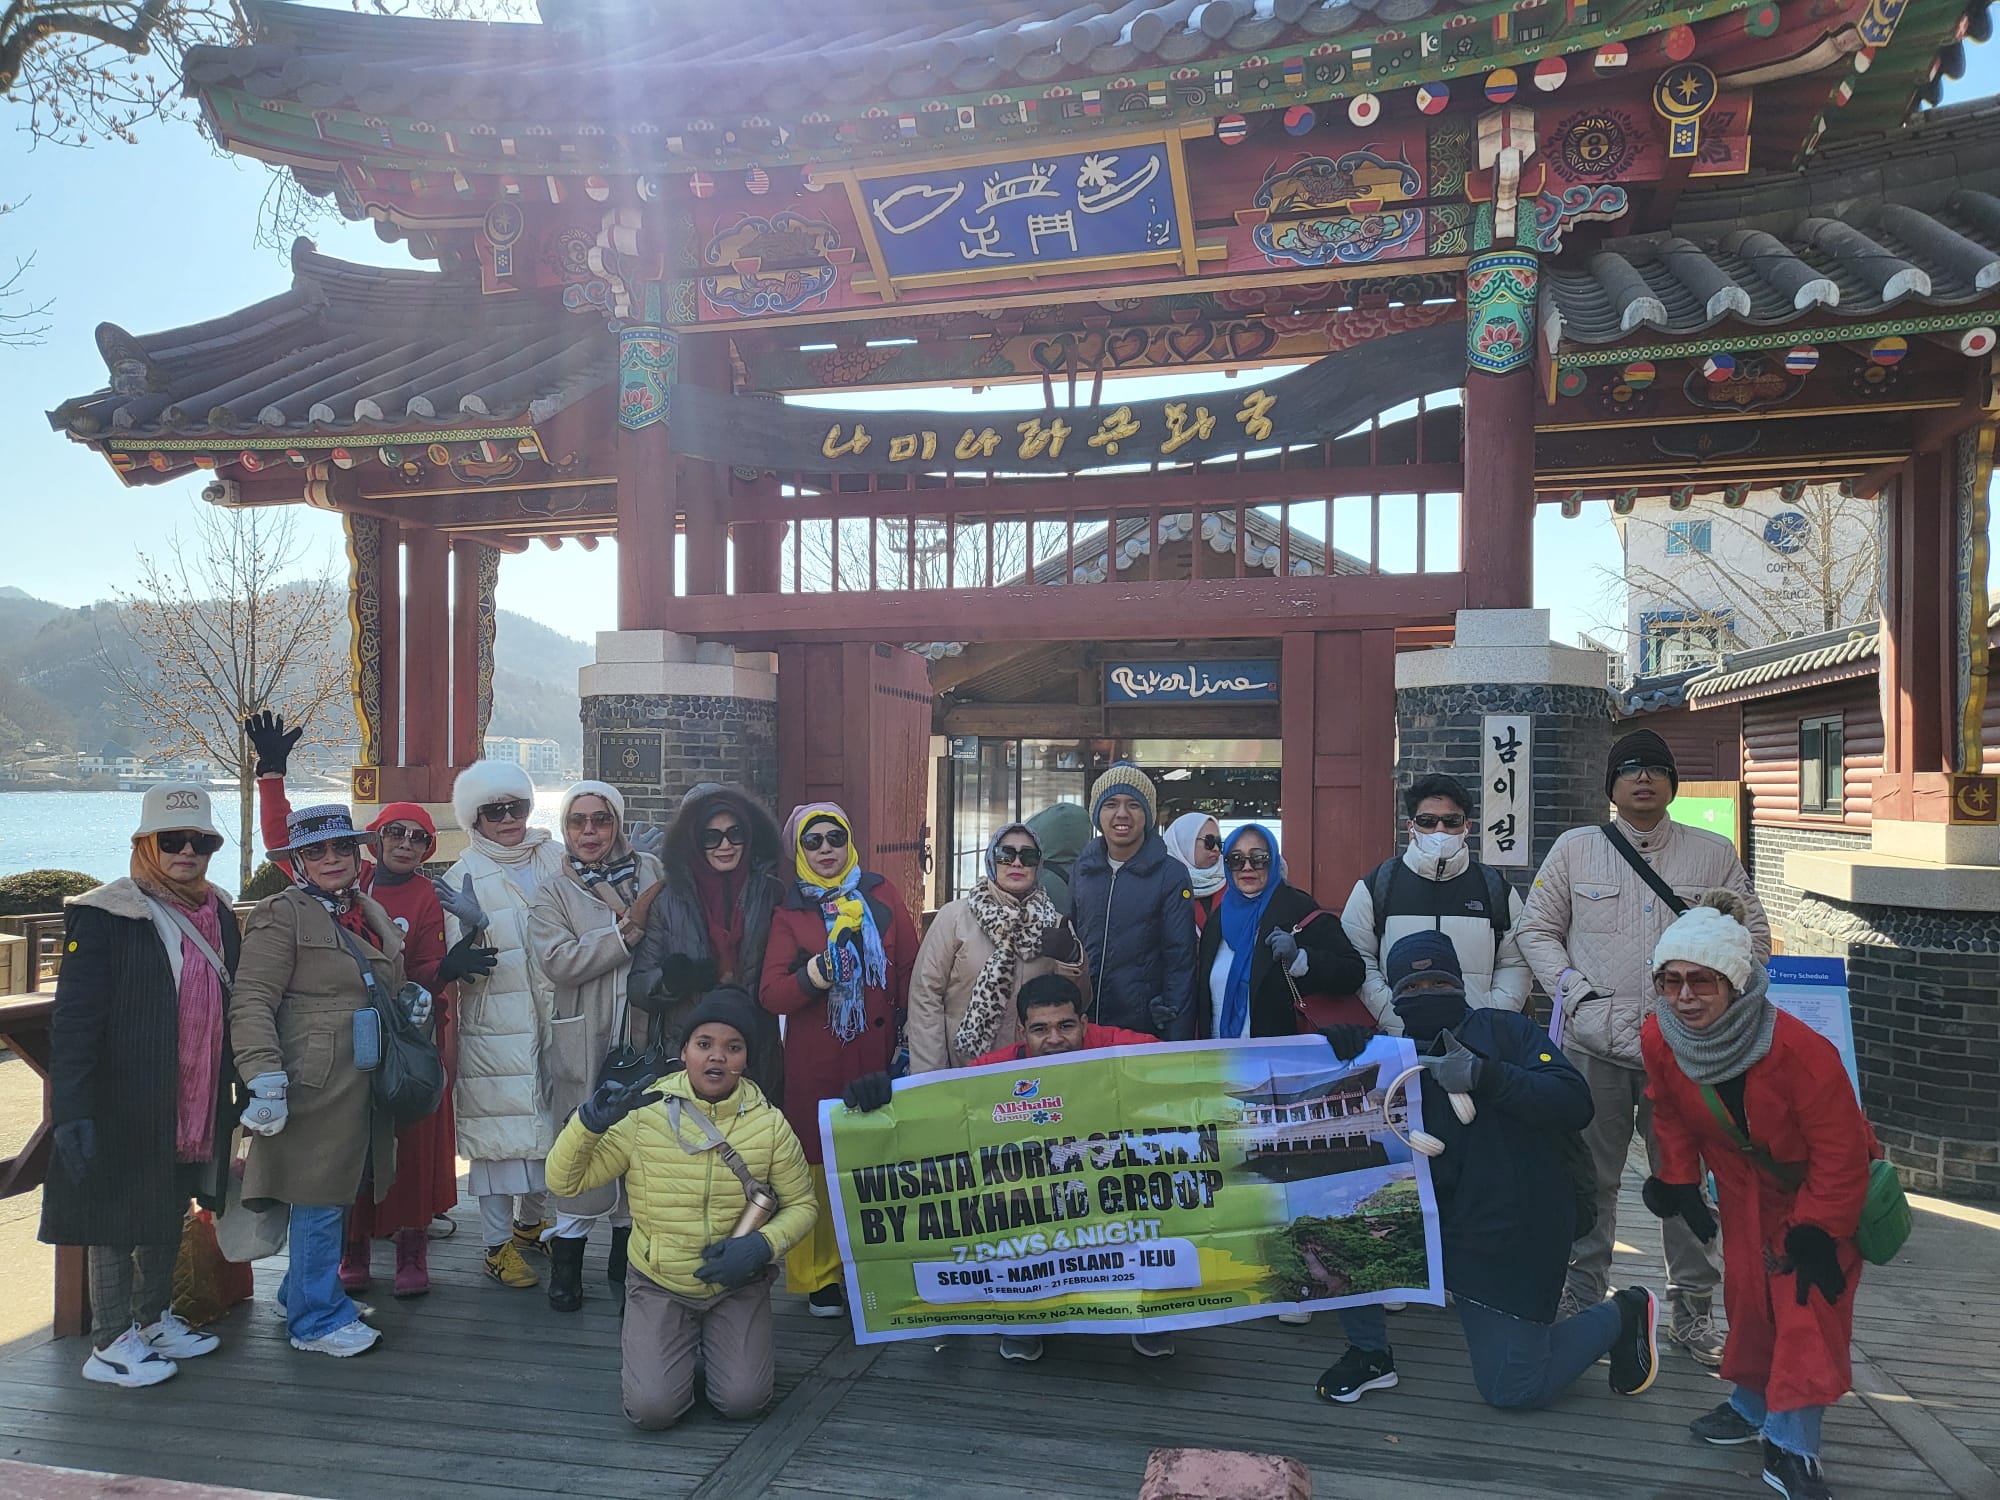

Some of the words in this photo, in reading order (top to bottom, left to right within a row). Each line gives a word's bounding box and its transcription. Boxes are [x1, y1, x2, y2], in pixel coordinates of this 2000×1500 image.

[1487, 725, 1523, 852] 남이섬
[1779, 971, 1797, 980] Ferry
[1798, 972, 1829, 980] Schedule
[993, 1096, 1064, 1115] Alkhalid
[993, 1112, 1030, 1123] Group
[852, 1151, 977, 1204] WISATA
[860, 1205, 908, 1245] BY
[918, 1179, 1090, 1241] ALKHALID
[1097, 1170, 1224, 1215] GROUP
[952, 1246, 968, 1263] 7
[975, 1234, 1048, 1263] DAYS
[1053, 1230, 1072, 1249] 6
[1075, 1219, 1162, 1246] NIGHT
[937, 1268, 994, 1286] SEOUL
[1007, 1260, 1056, 1283] NAMI
[1059, 1251, 1125, 1274] ISLAND
[1139, 1249, 1177, 1268] JEJU
[983, 1286, 994, 1295] 15
[995, 1284, 1042, 1294] FEBRUARI
[1052, 1279, 1061, 1289] 21
[1063, 1274, 1110, 1286] FEBRUARI
[1112, 1273, 1136, 1283] 2025
[890, 1316, 904, 1325] Jl.
[906, 1313, 1015, 1325] Sisingamangaraja
[1018, 1311, 1047, 1321] Km.9
[1050, 1307, 1085, 1319] No.2A
[1087, 1305, 1133, 1316] Medan,
[1136, 1300, 1196, 1314] Sumatera
[1197, 1295, 1233, 1307] Utara
